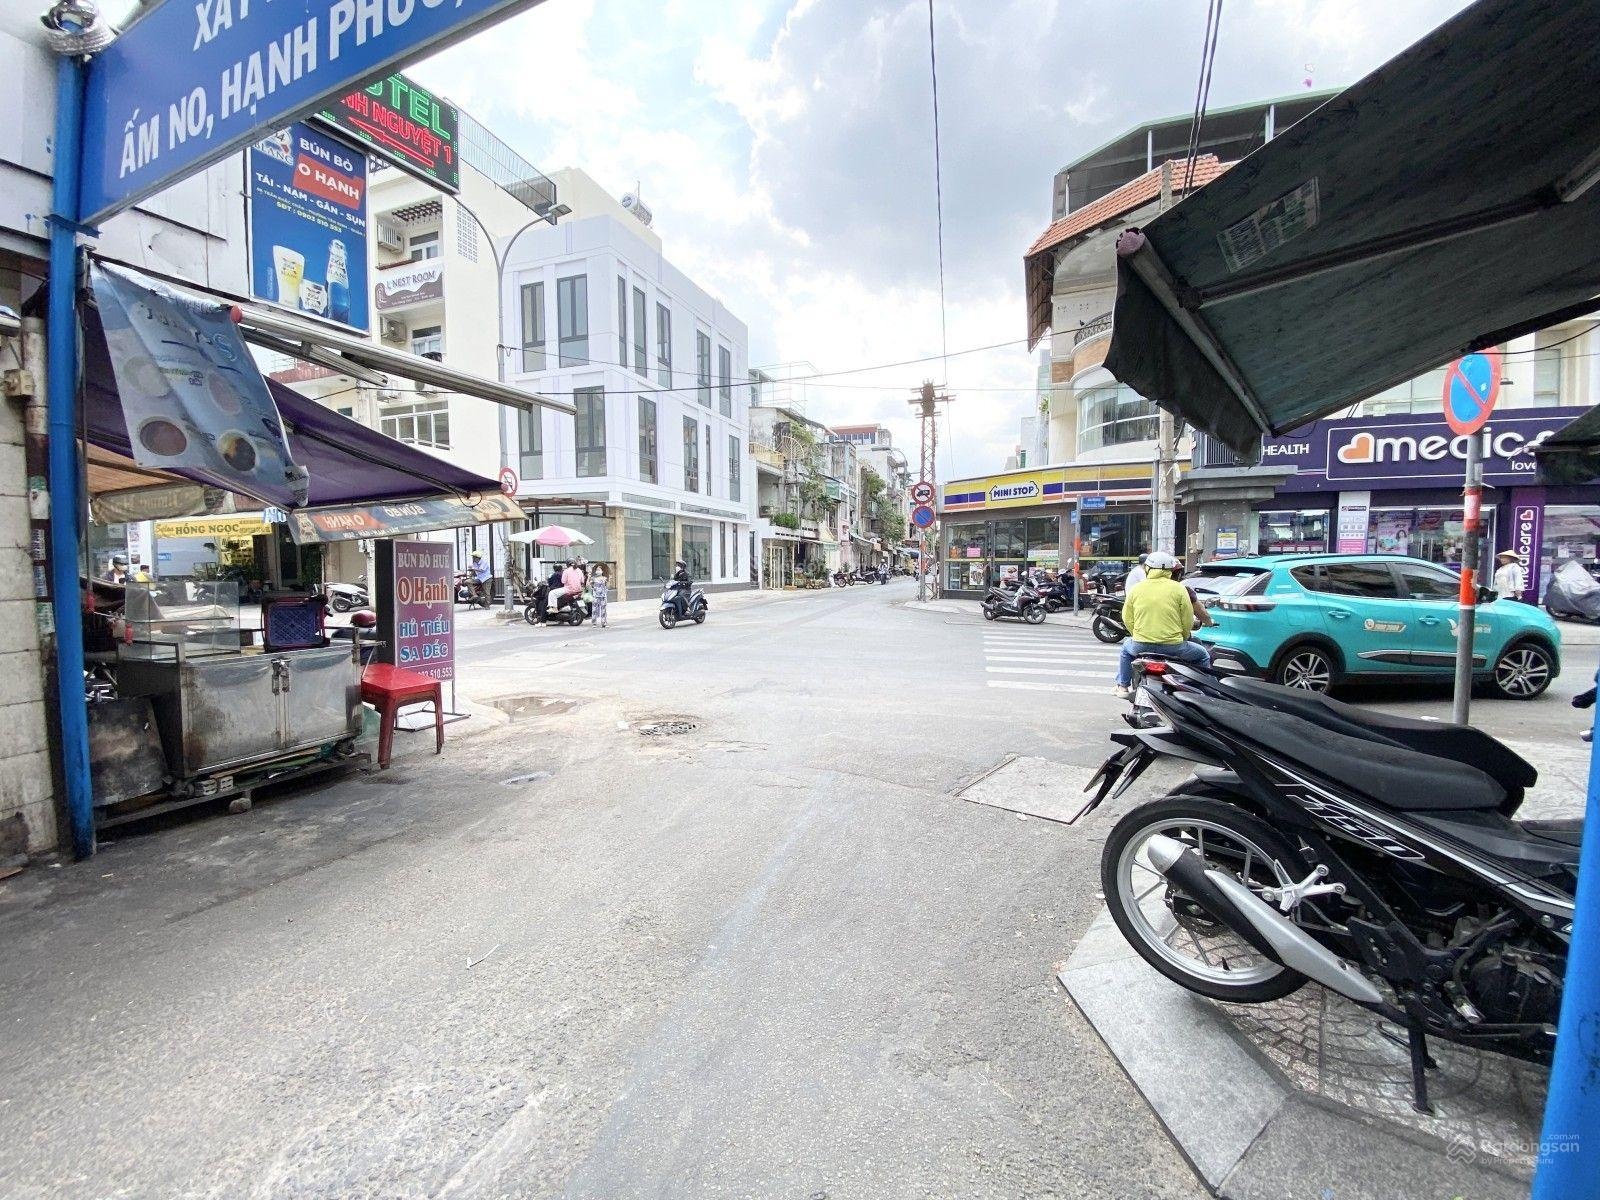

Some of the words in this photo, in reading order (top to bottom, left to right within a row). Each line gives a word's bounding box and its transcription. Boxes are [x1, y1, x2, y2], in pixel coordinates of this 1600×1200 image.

[119, 108, 160, 180] ẤM
[169, 86, 214, 150] NO,
[221, 16, 318, 120] HẠNH
[372, 101, 442, 158] NGUYỆT
[443, 145, 452, 165] 1
[300, 137, 330, 162] BÚN
[333, 154, 354, 172] BÒ
[298, 162, 311, 176] O
[315, 169, 360, 201] HẠNH
[276, 201, 292, 213] SĐT
[283, 185, 308, 202] NẠM
[346, 213, 366, 228] SỤN
[412, 270, 436, 284] ROOM
[1262, 443, 1310, 456] HEALTH
[993, 488, 1011, 498] MINI
[1012, 486, 1034, 496] STOP
[208, 524, 239, 535] NGỌC
[397, 548, 417, 568] BÚN
[418, 549, 431, 568] BÒ
[432, 548, 450, 569] HUẾ
[397, 576, 412, 605] O
[412, 576, 450, 609] Hạnh
[400, 646, 420, 662] SA
[422, 639, 448, 661] ĐÉC
